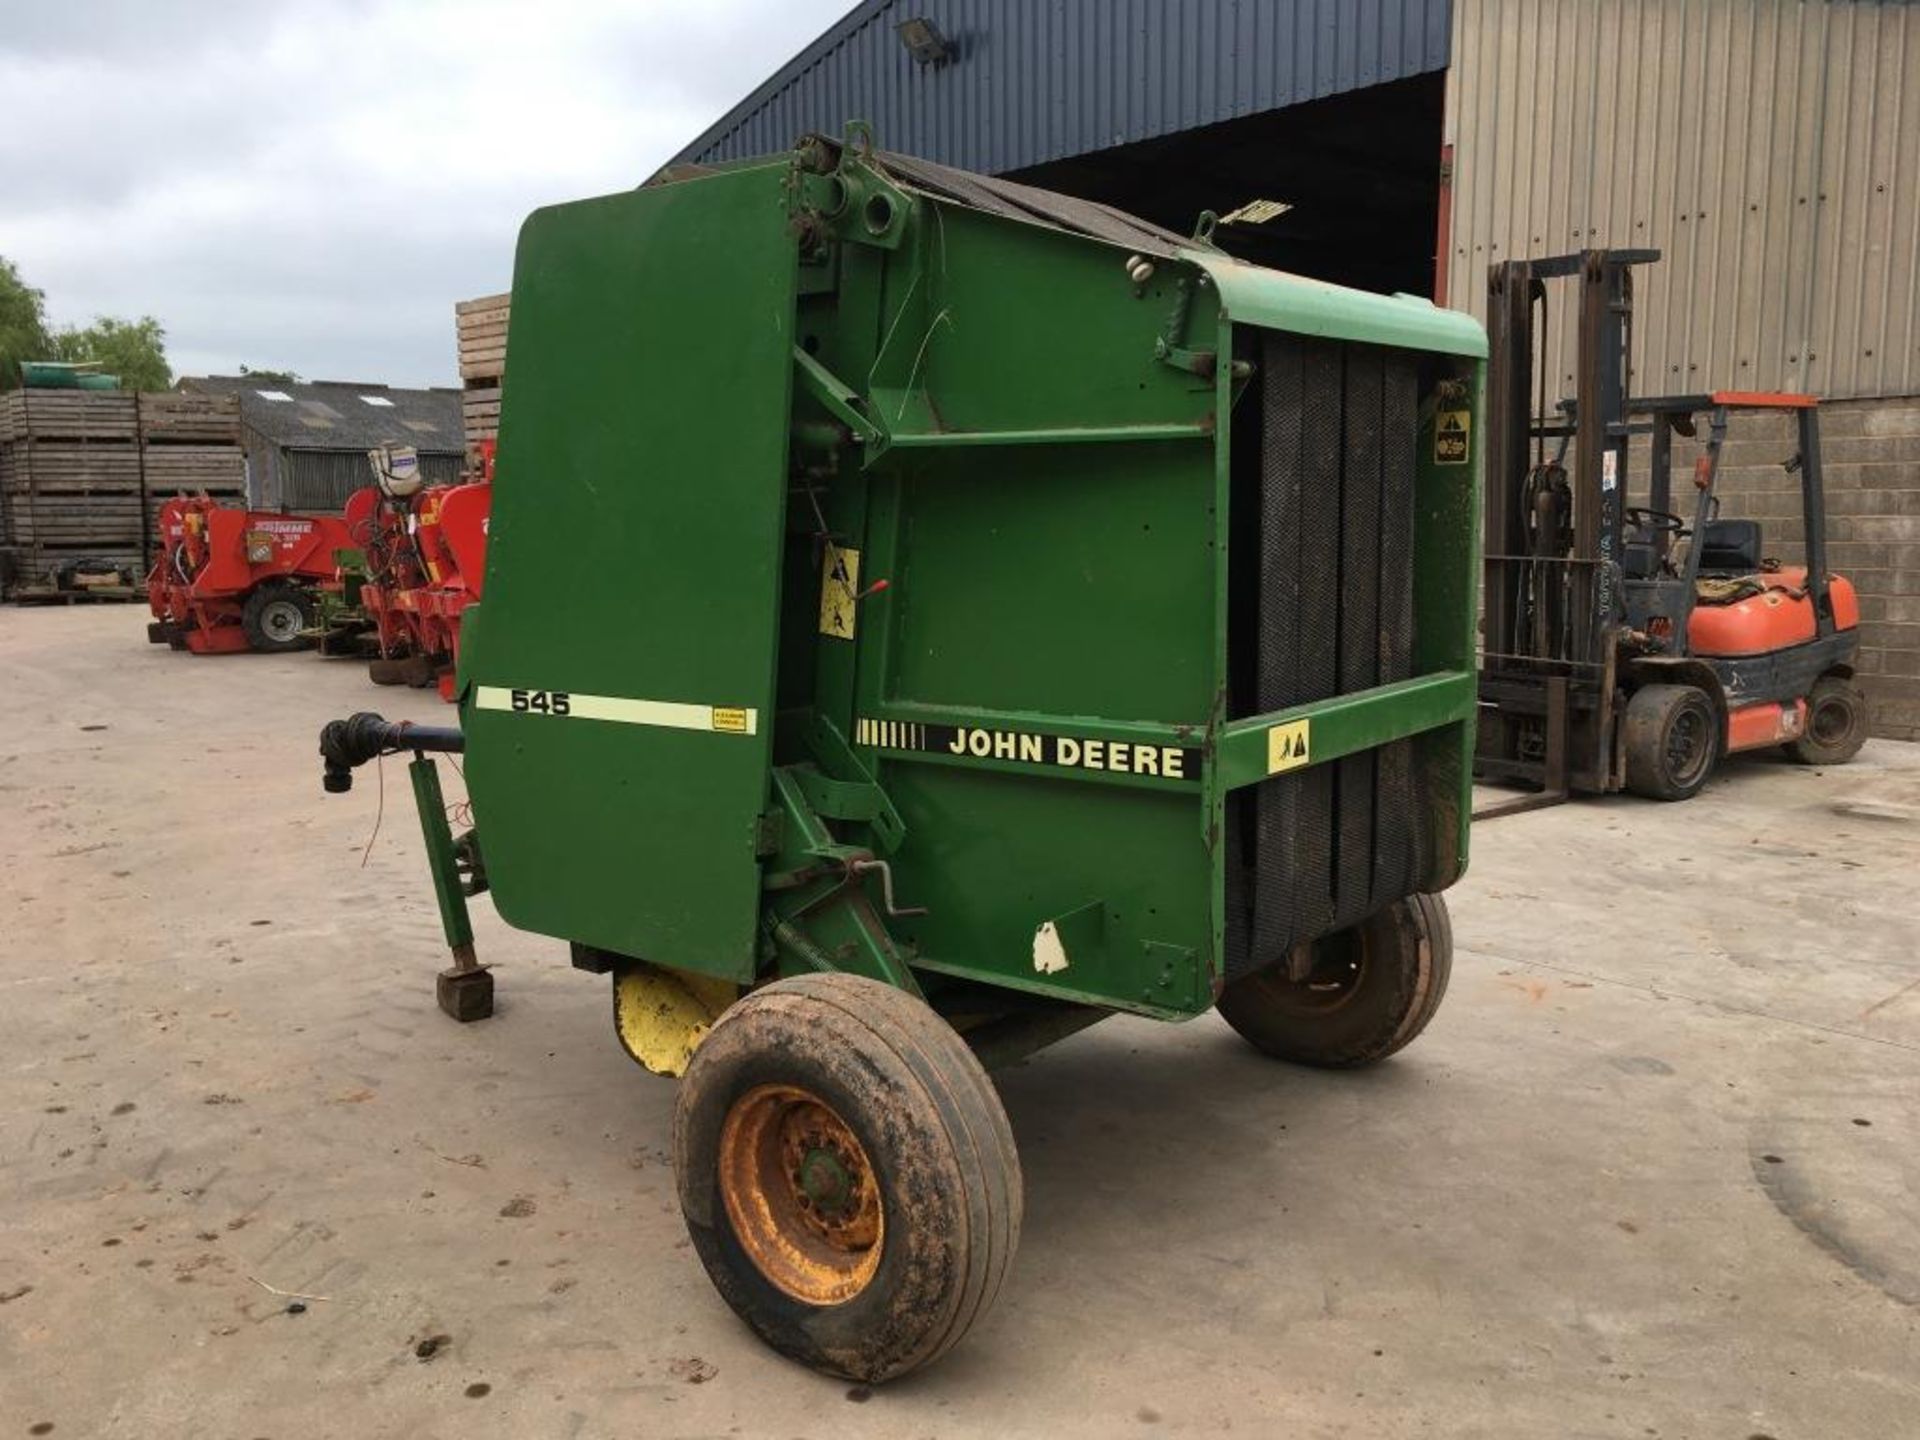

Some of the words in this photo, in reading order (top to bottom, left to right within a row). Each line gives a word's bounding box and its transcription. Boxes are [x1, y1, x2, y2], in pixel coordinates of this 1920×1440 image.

[512, 689, 570, 715] 545
[949, 728, 1042, 762] JOHN
[1057, 737, 1184, 779] DEERE
